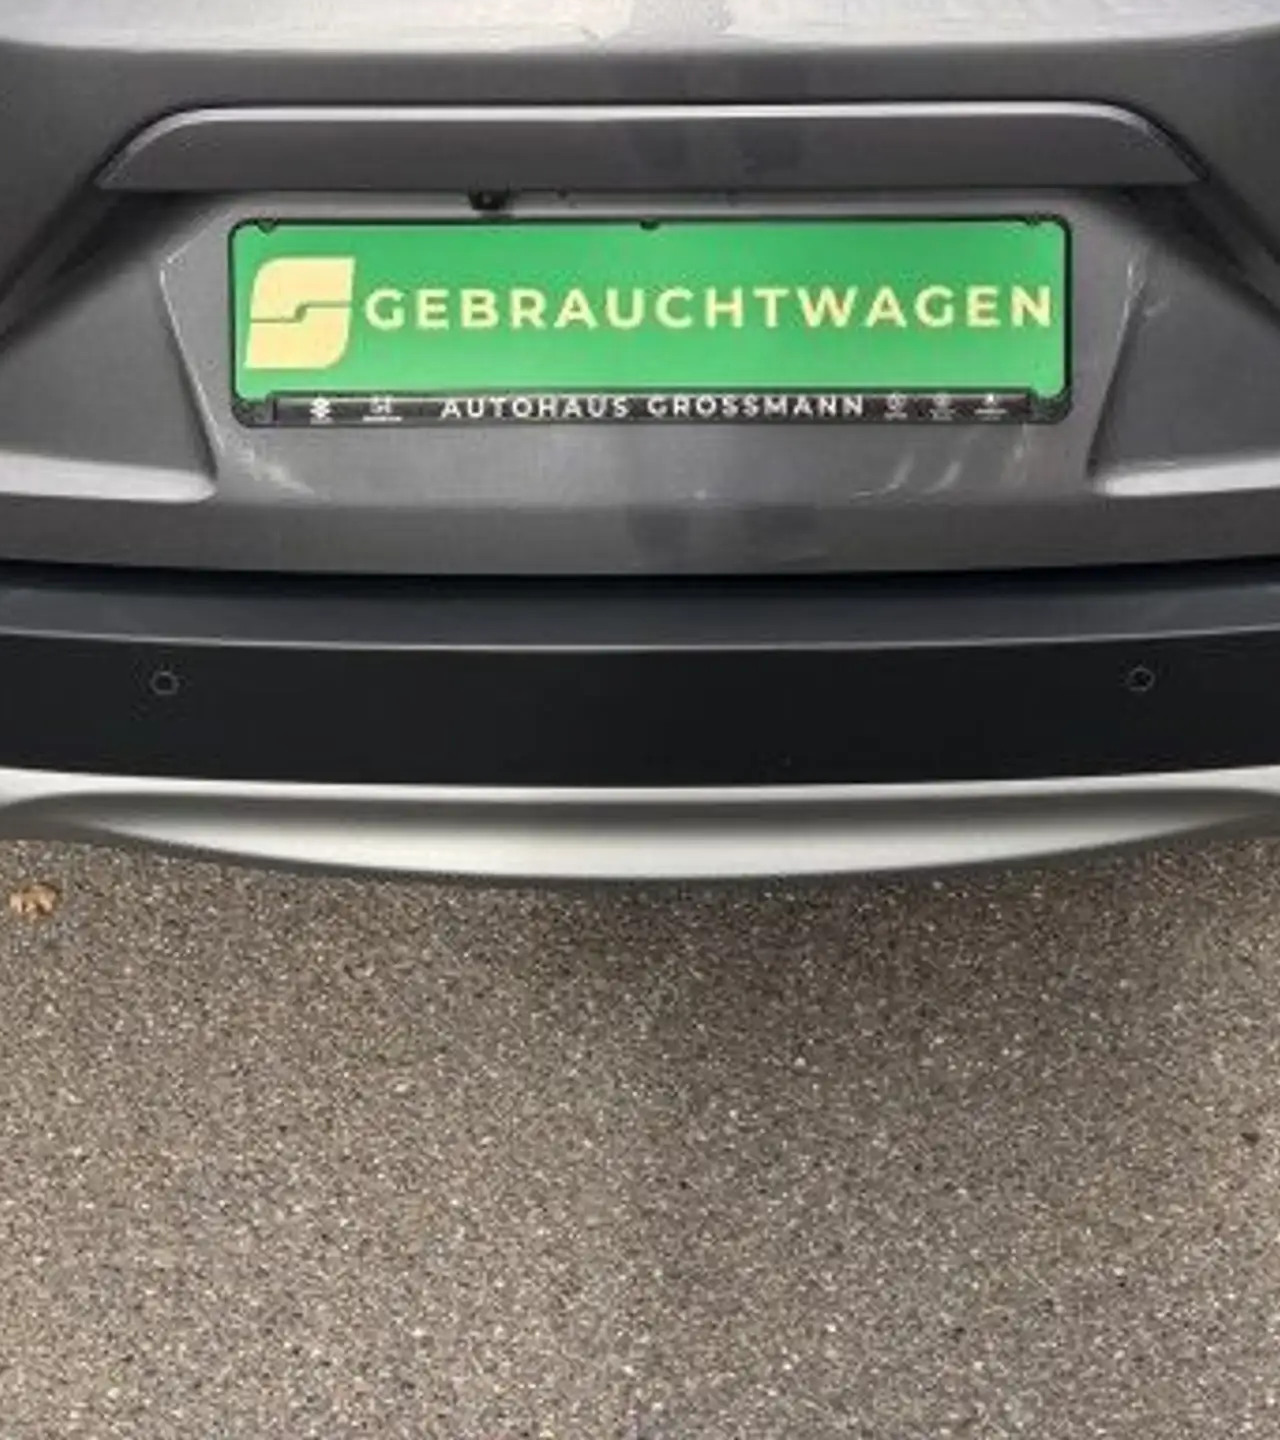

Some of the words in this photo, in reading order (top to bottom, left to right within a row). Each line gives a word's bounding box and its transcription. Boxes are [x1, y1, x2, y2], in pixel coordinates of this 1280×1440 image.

[362, 284, 1054, 331] GEBRAUCHTWAGEN
[439, 394, 631, 420] AUTOHAUS
[646, 392, 865, 419] GROSSMANN
